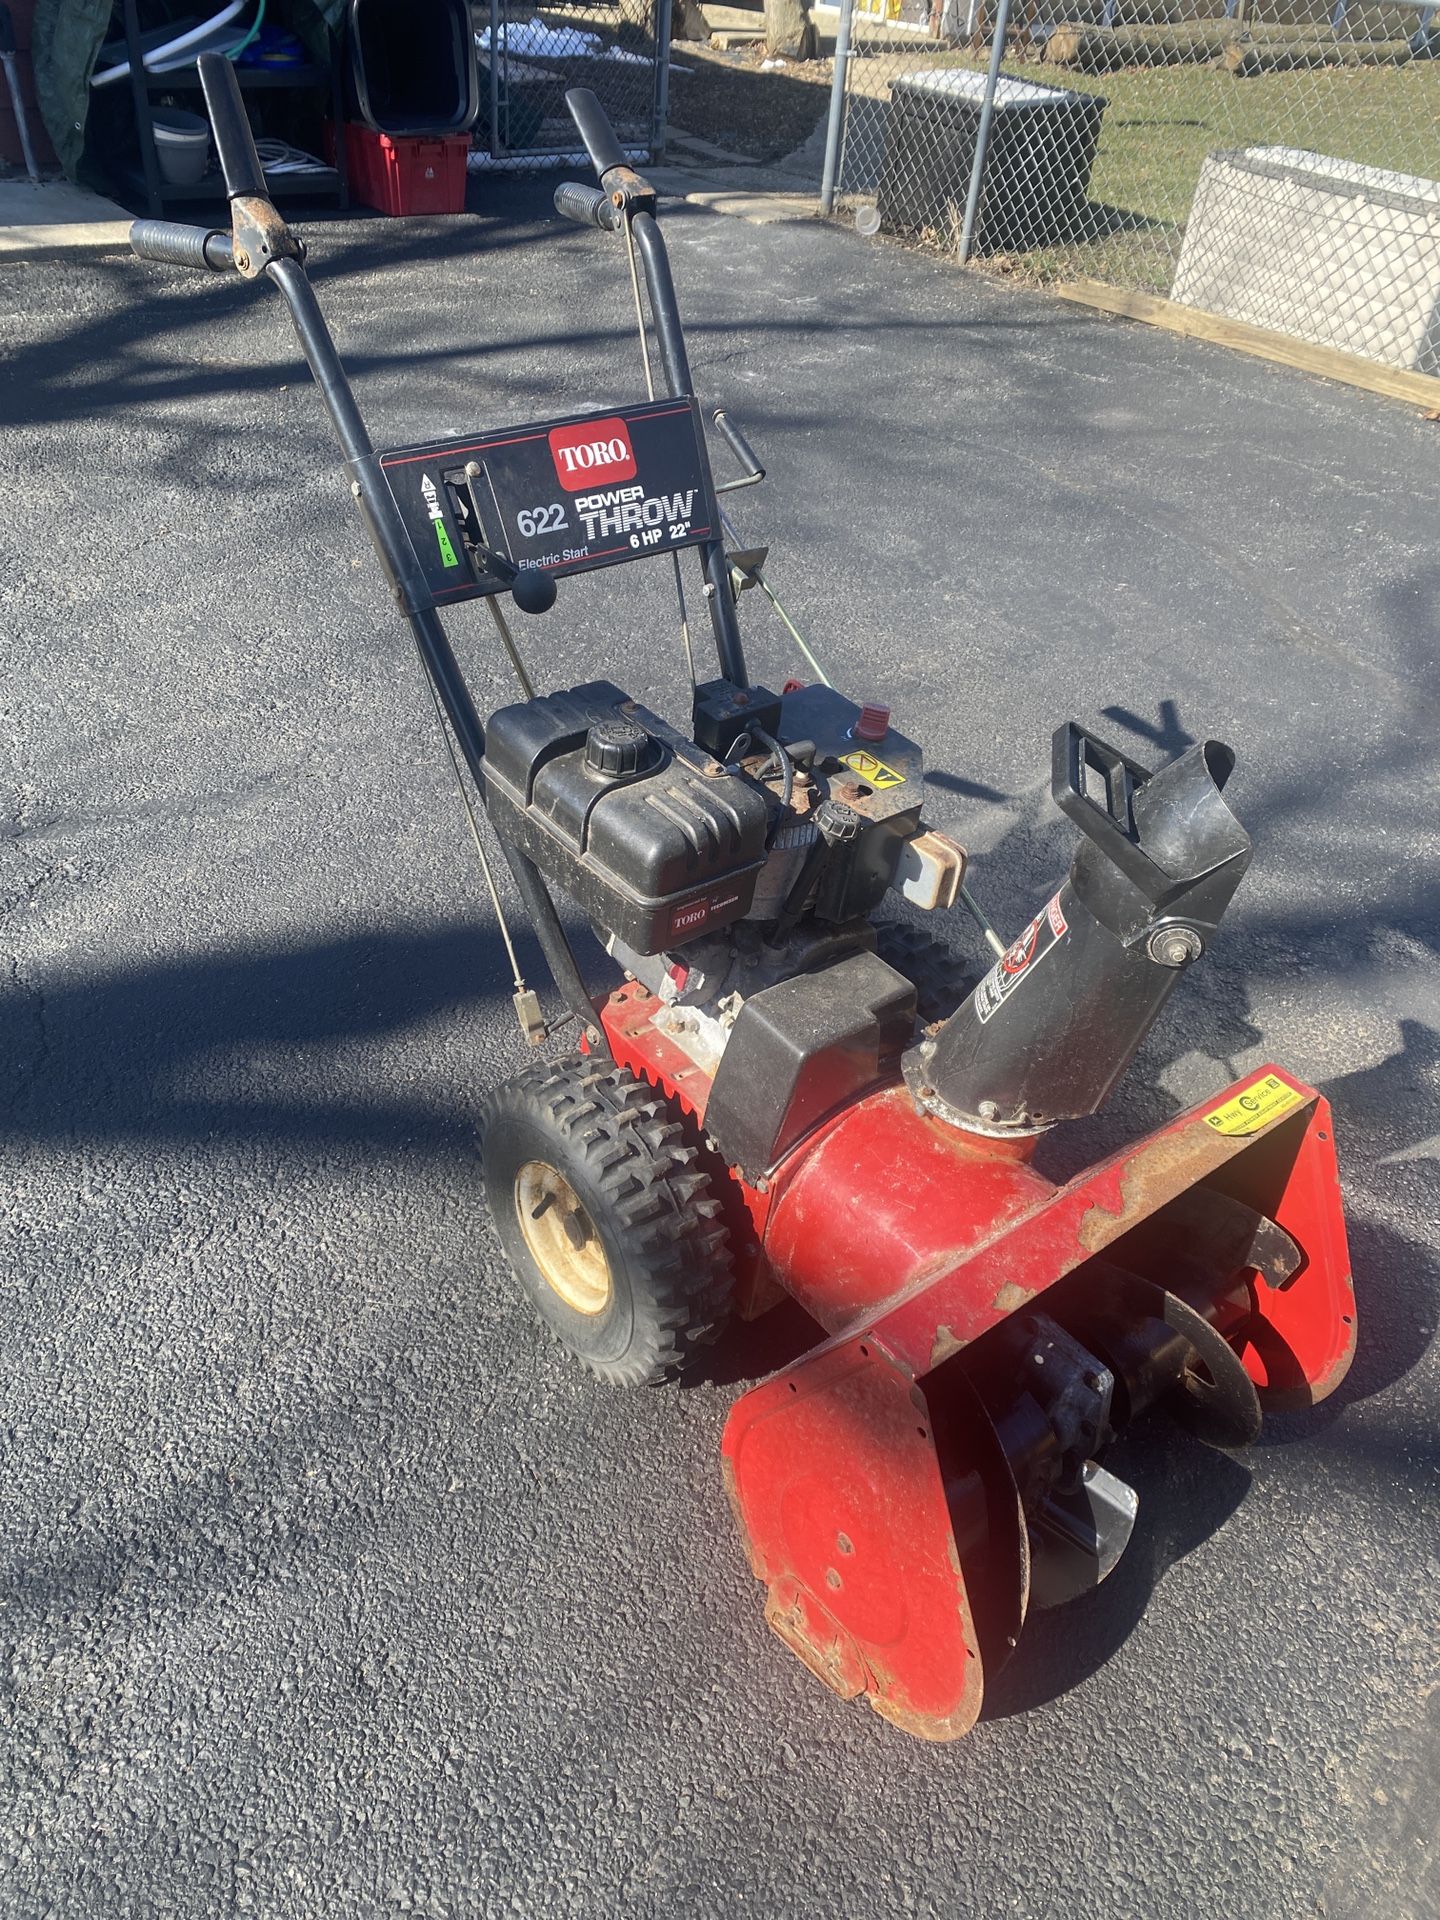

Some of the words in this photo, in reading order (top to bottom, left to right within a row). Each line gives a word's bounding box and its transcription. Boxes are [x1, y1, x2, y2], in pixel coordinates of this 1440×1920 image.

[558, 438, 627, 472] TORO
[575, 485, 645, 512] POWER
[516, 503, 569, 537] 622
[579, 489, 695, 540] THROW
[629, 534, 640, 549] 6
[642, 529, 662, 546] HP
[669, 521, 691, 540] 22"
[518, 551, 560, 571] Electric
[562, 545, 589, 562] Start
[675, 909, 705, 929] TORO
[1223, 1108, 1243, 1121] Hwy
[1244, 1089, 1271, 1107] Service
